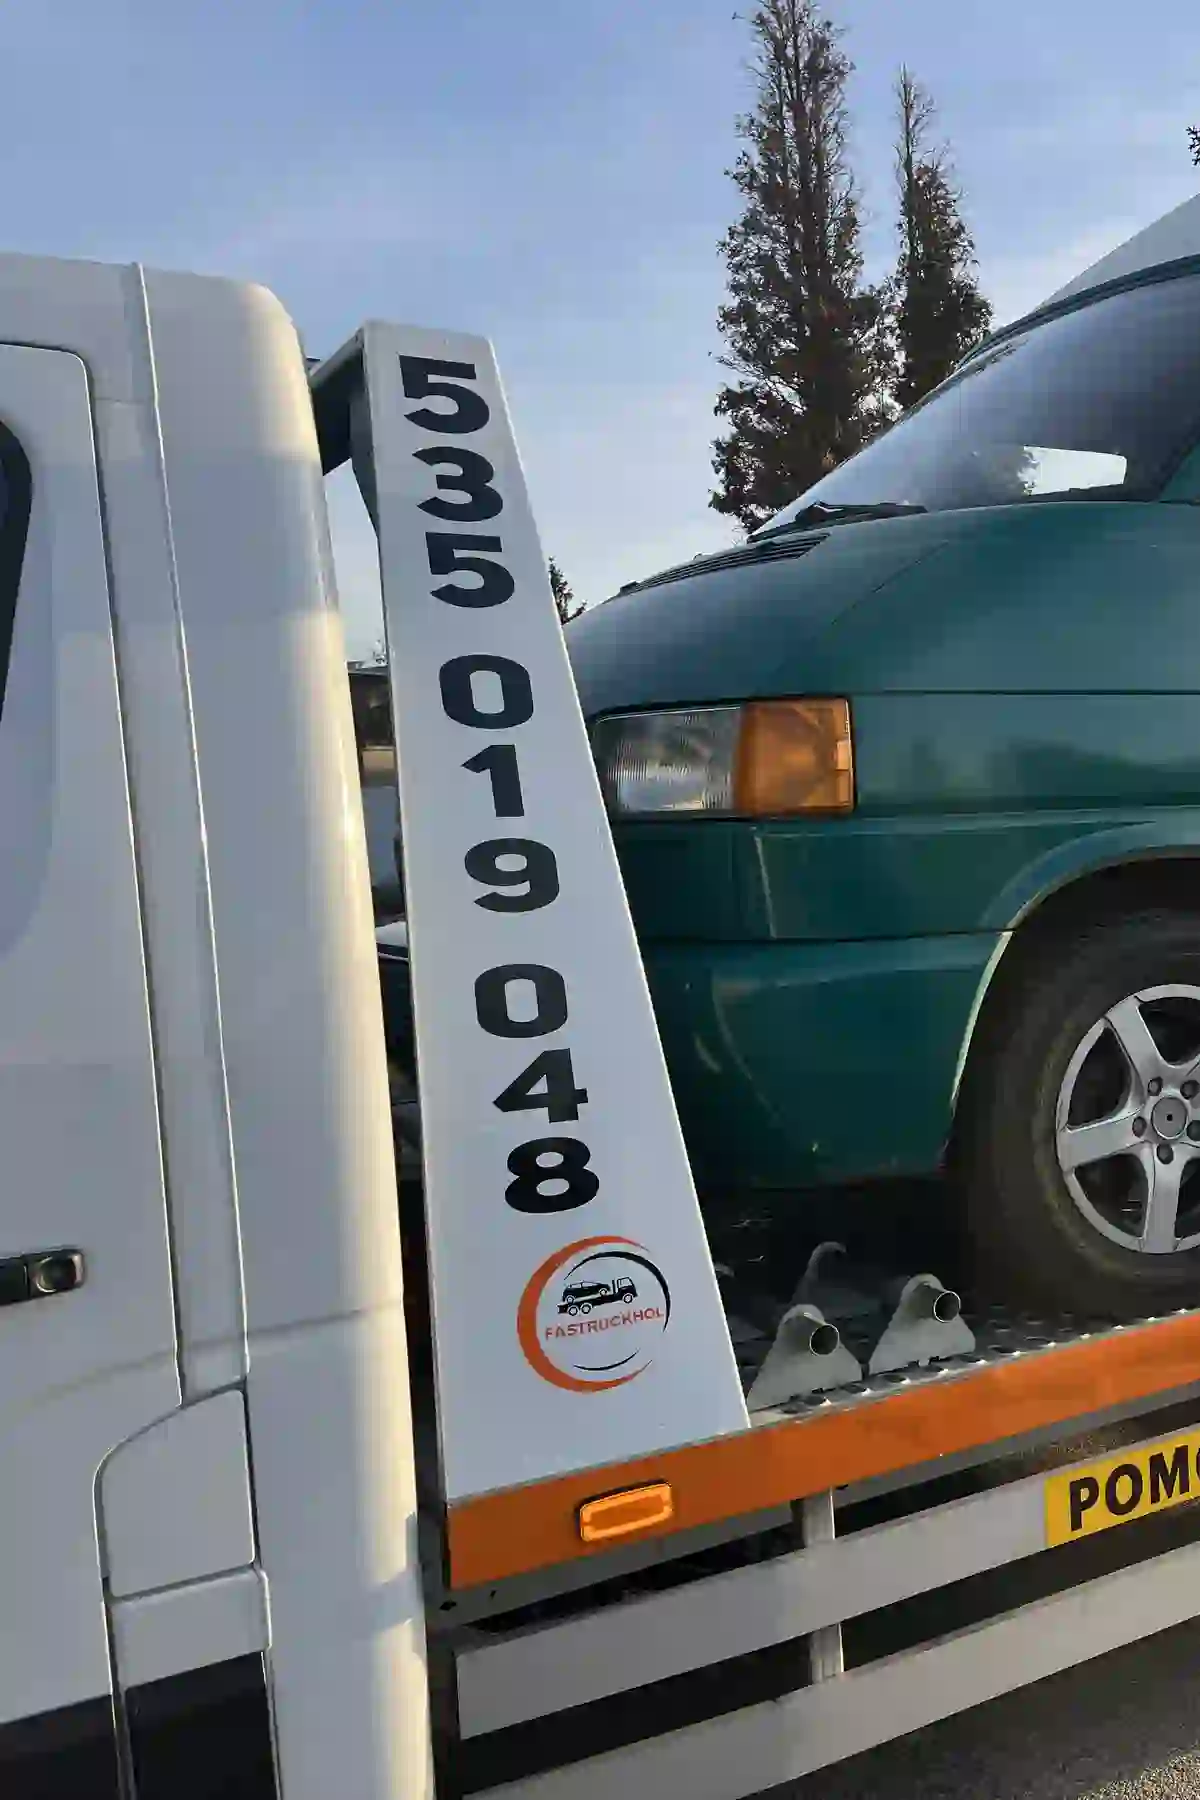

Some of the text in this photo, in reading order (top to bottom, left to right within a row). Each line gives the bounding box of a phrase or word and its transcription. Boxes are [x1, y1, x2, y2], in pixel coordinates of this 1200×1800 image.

[398, 354, 600, 1214] 535 019 048
[545, 1307, 665, 1341] FASTRUCKHOL
